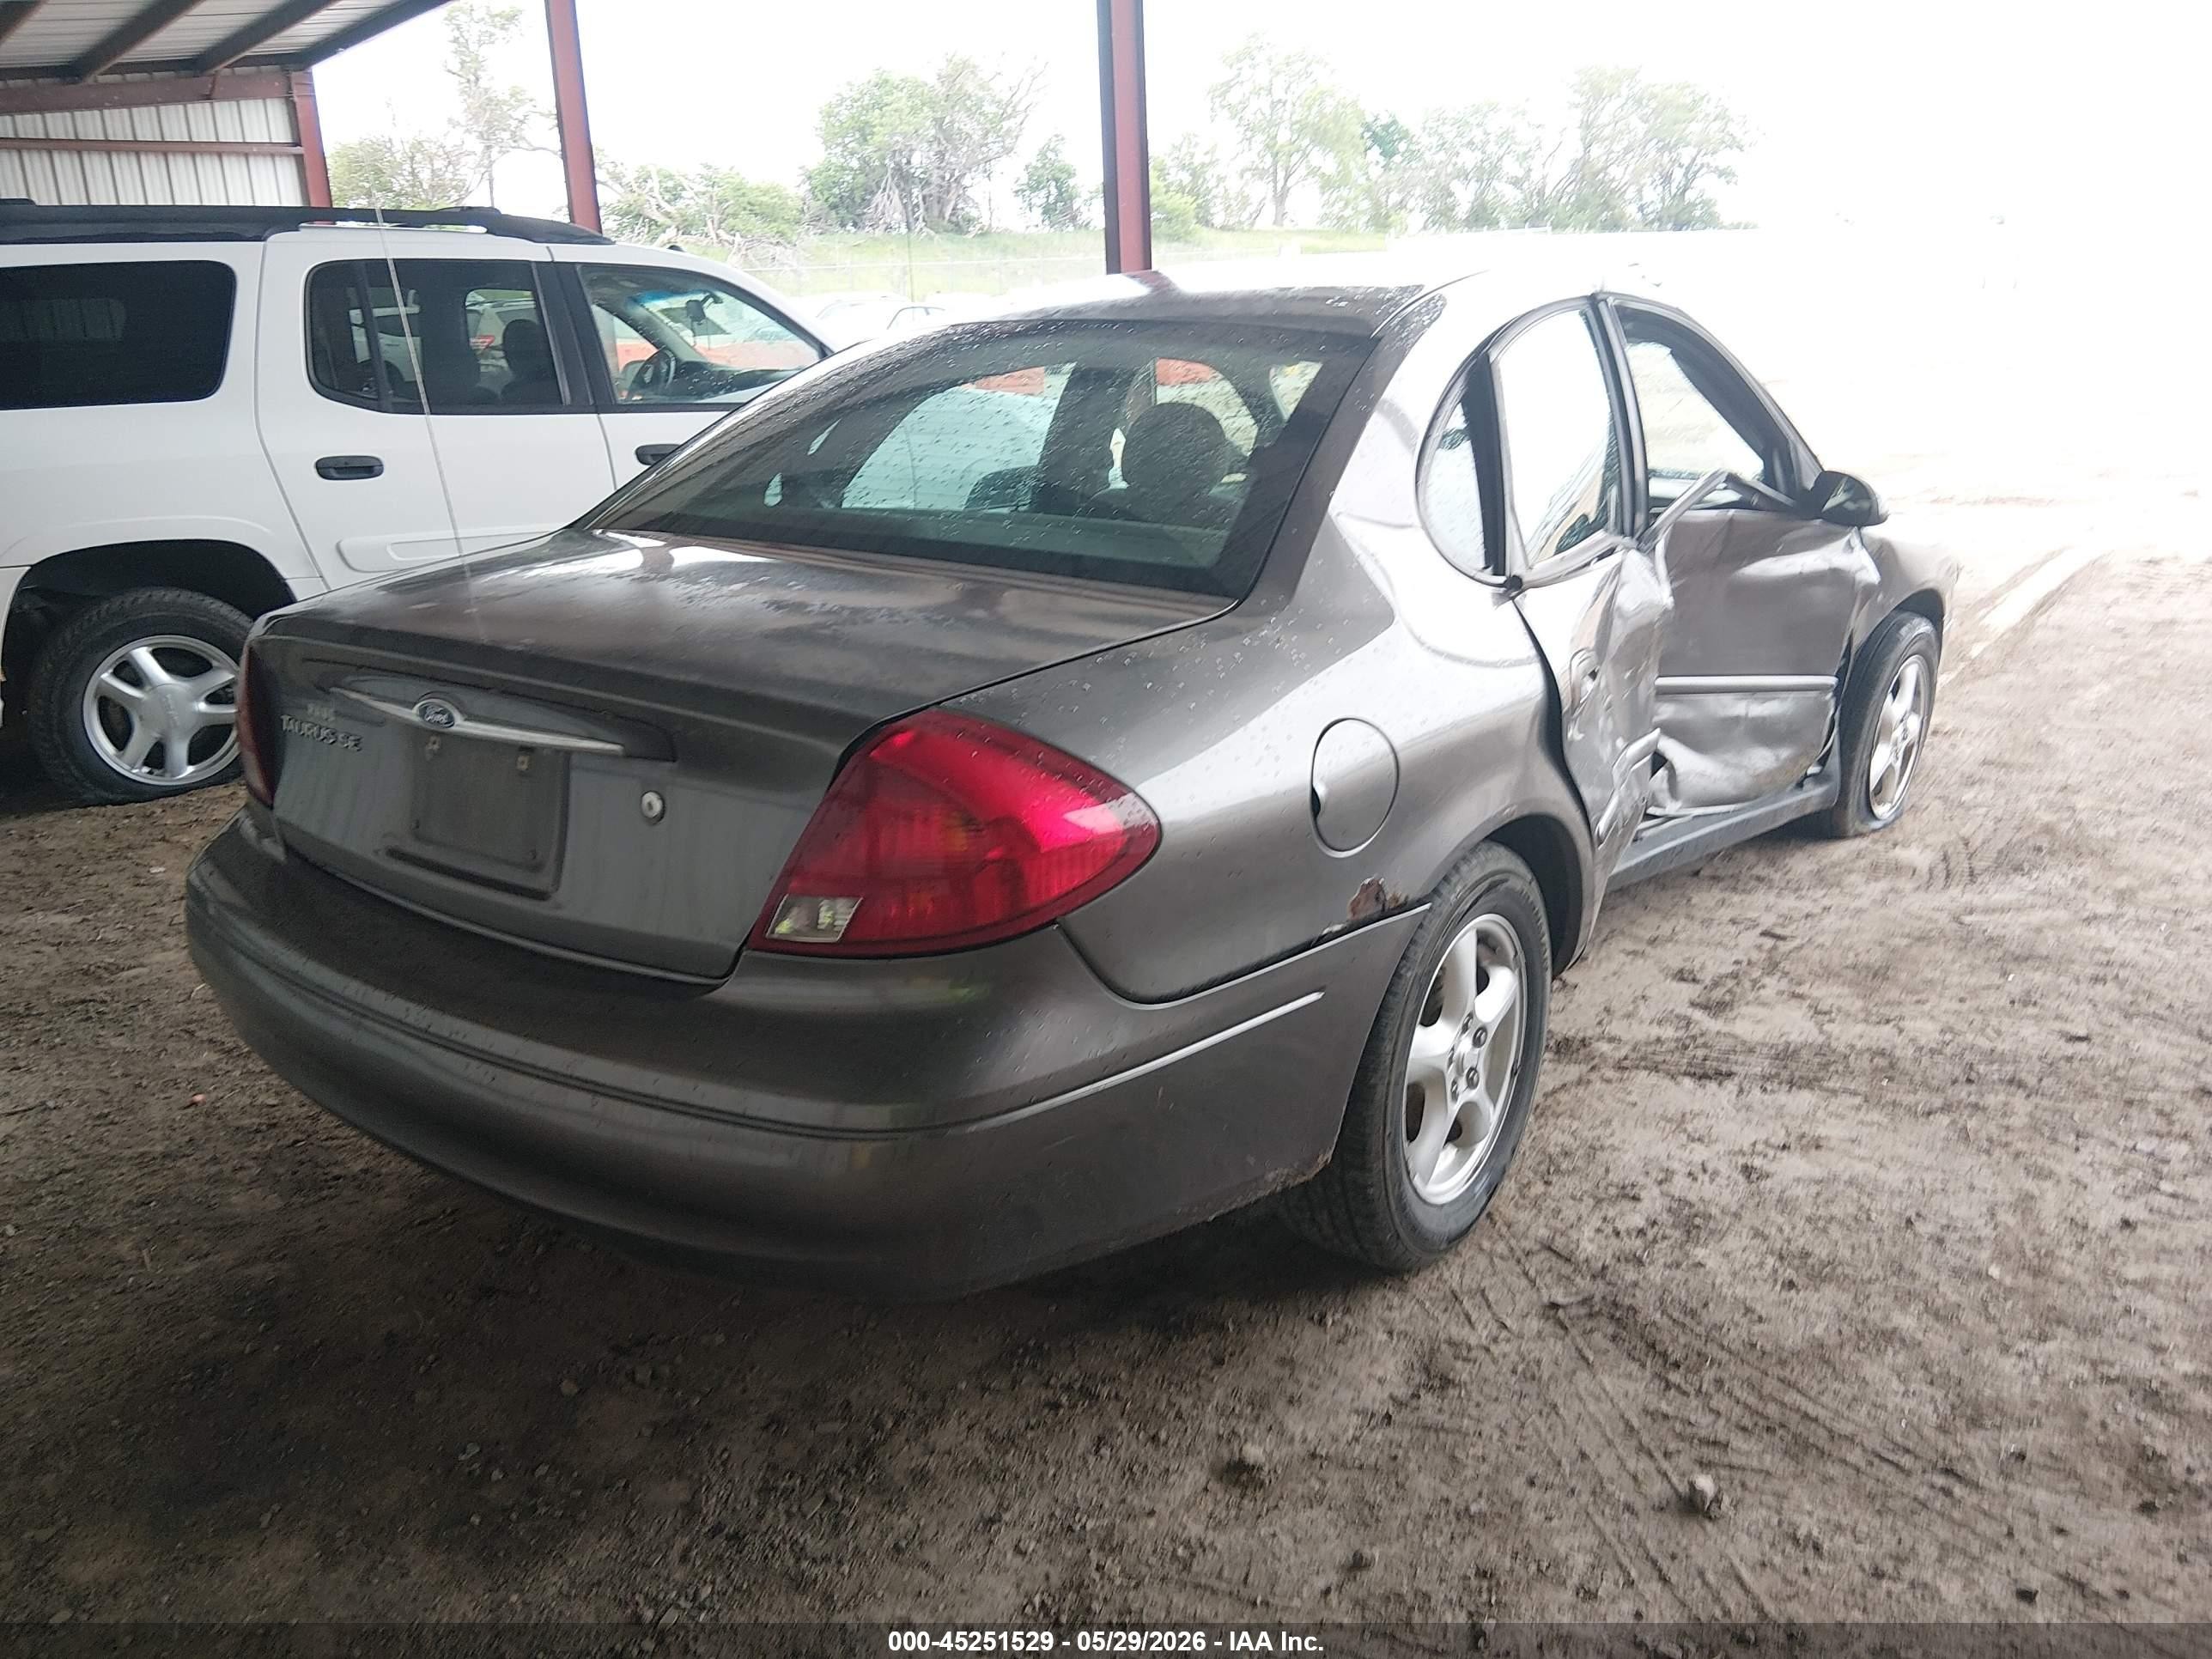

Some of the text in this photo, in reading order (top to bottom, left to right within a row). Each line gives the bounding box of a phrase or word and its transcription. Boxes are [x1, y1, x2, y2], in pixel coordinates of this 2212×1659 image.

[422, 704, 449, 724] Ford
[280, 714, 364, 751] TAURUS SE
